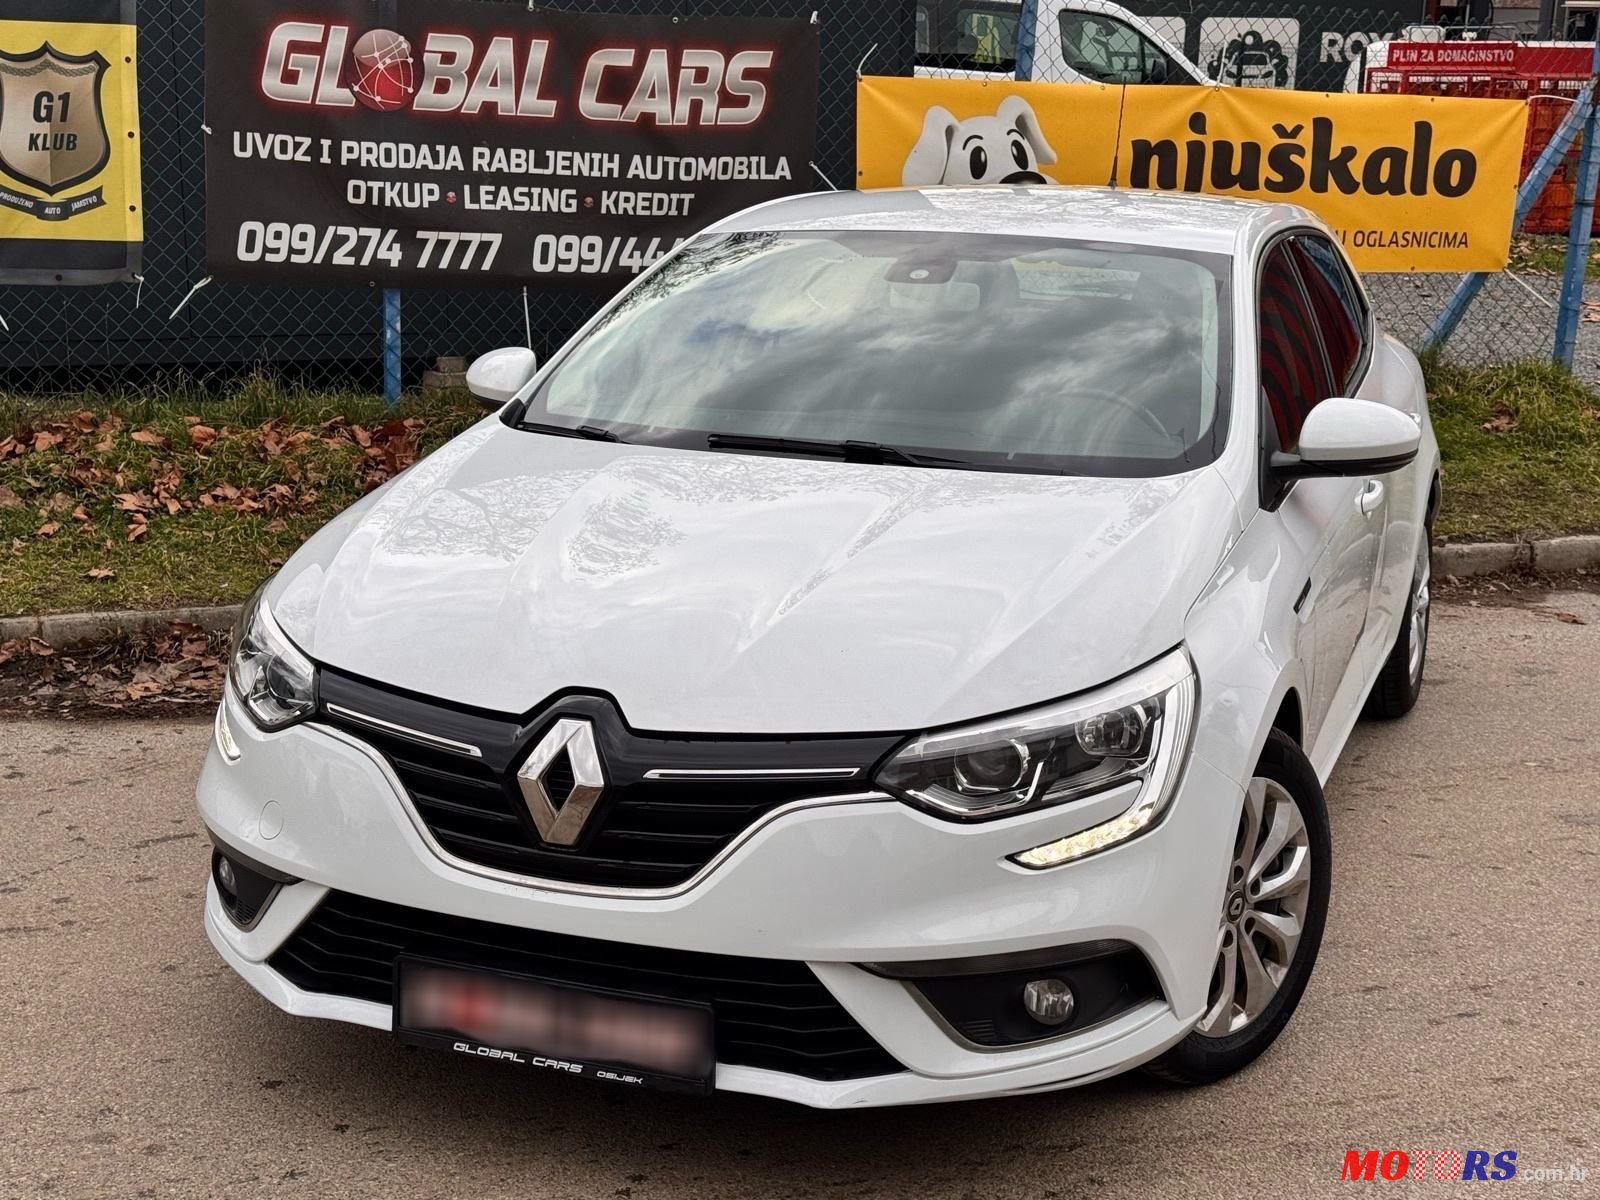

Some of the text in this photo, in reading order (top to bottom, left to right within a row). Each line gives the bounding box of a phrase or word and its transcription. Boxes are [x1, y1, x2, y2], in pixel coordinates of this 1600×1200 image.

[1320, 31, 1394, 63] RO
[1392, 49, 1418, 62] PLIN
[1420, 50, 1435, 62] ZA
[261, 21, 774, 126] GLOBAL CARS
[32, 91, 71, 123] G1
[28, 133, 78, 151] KLUB
[233, 131, 792, 181] UVOZ I PRODAJA RABLJENIH AUTOMOBILA
[1130, 112, 1477, 198] njuškalo
[44, 206, 61, 215] AUTO
[71, 195, 98, 212] JAMSTVO
[347, 179, 695, 216] OTKUP LEASING KREDIT
[237, 221, 402, 267] 099/274
[416, 230, 502, 271] 7777
[1353, 230, 1469, 249] OGLASNICIMA
[453, 1042, 643, 1085] GLOBAL CARS OSIJEK
